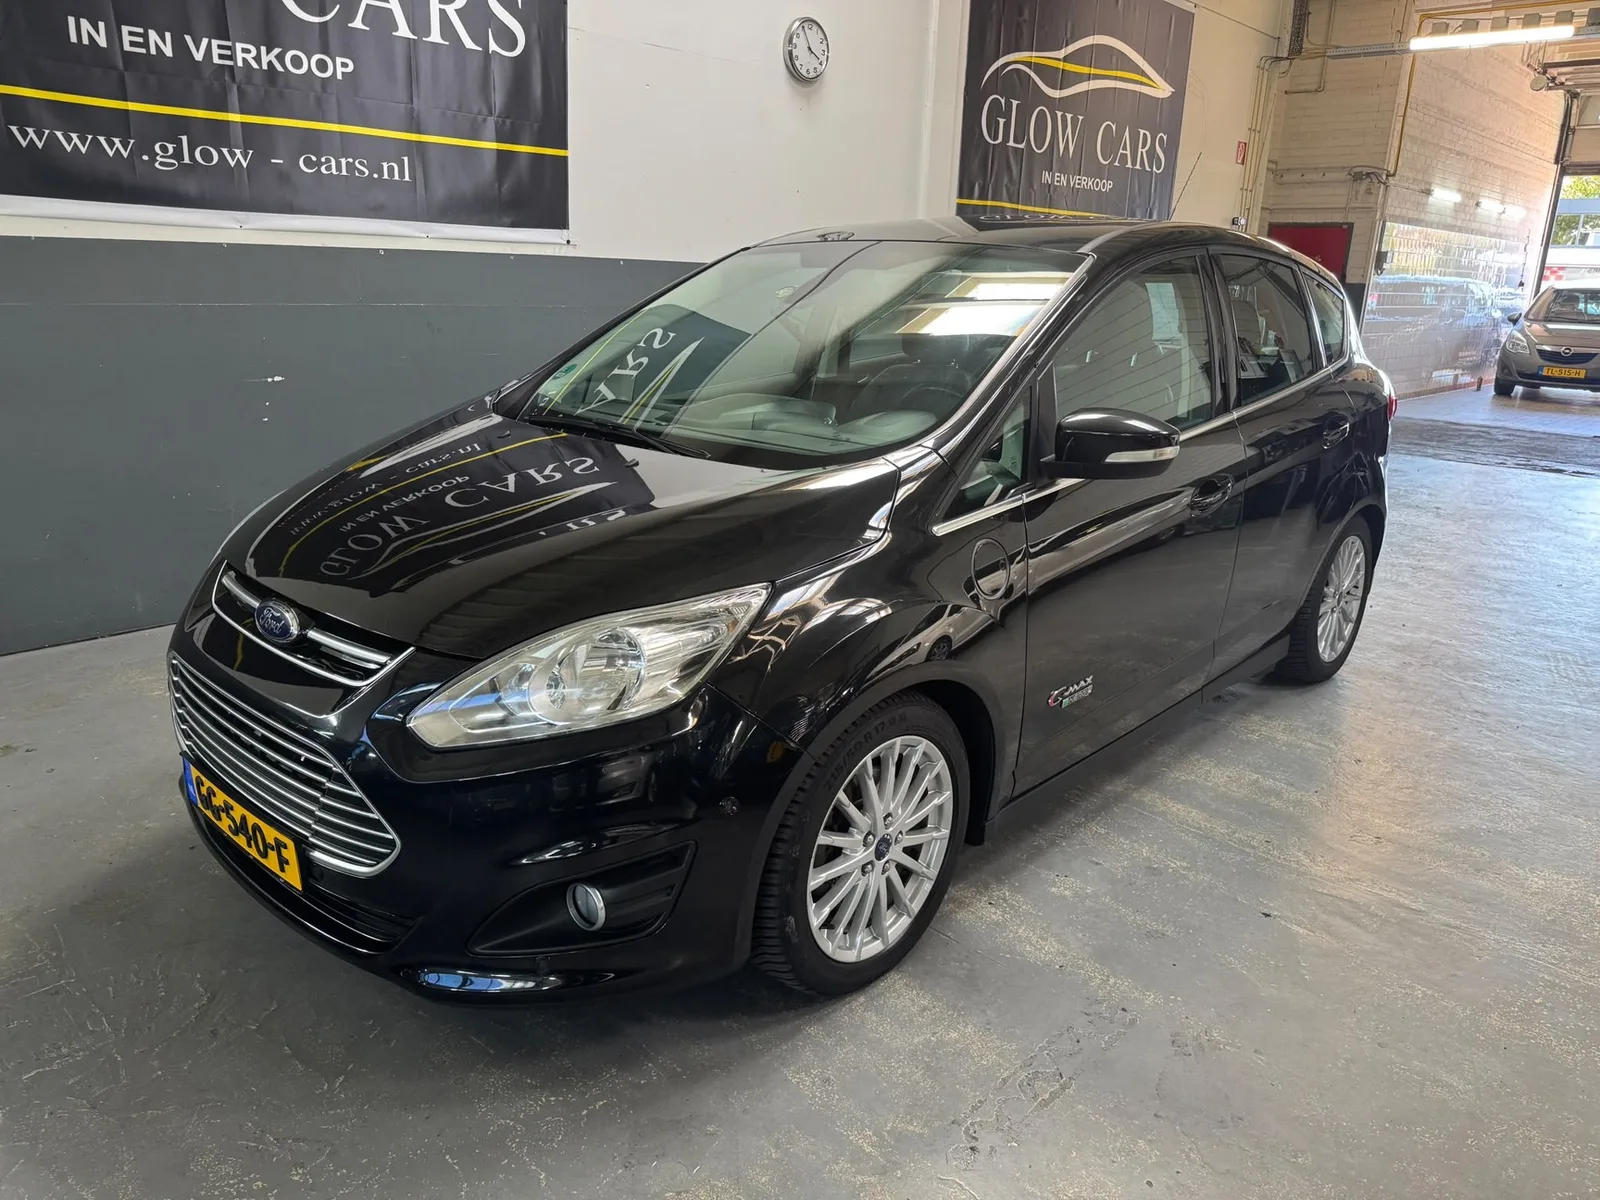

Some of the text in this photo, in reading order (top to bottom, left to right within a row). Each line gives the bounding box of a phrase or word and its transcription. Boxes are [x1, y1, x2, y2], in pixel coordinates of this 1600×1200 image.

[67, 15, 355, 81] IN EN VERKOOP
[8, 125, 254, 171] www.glow
[299, 154, 413, 182] cars.nl
[981, 94, 1168, 174] GLOW CARS
[1041, 170, 1114, 193] IN EN VERKOOP
[260, 607, 285, 634] Ford
[195, 775, 290, 874] GG-540-F
